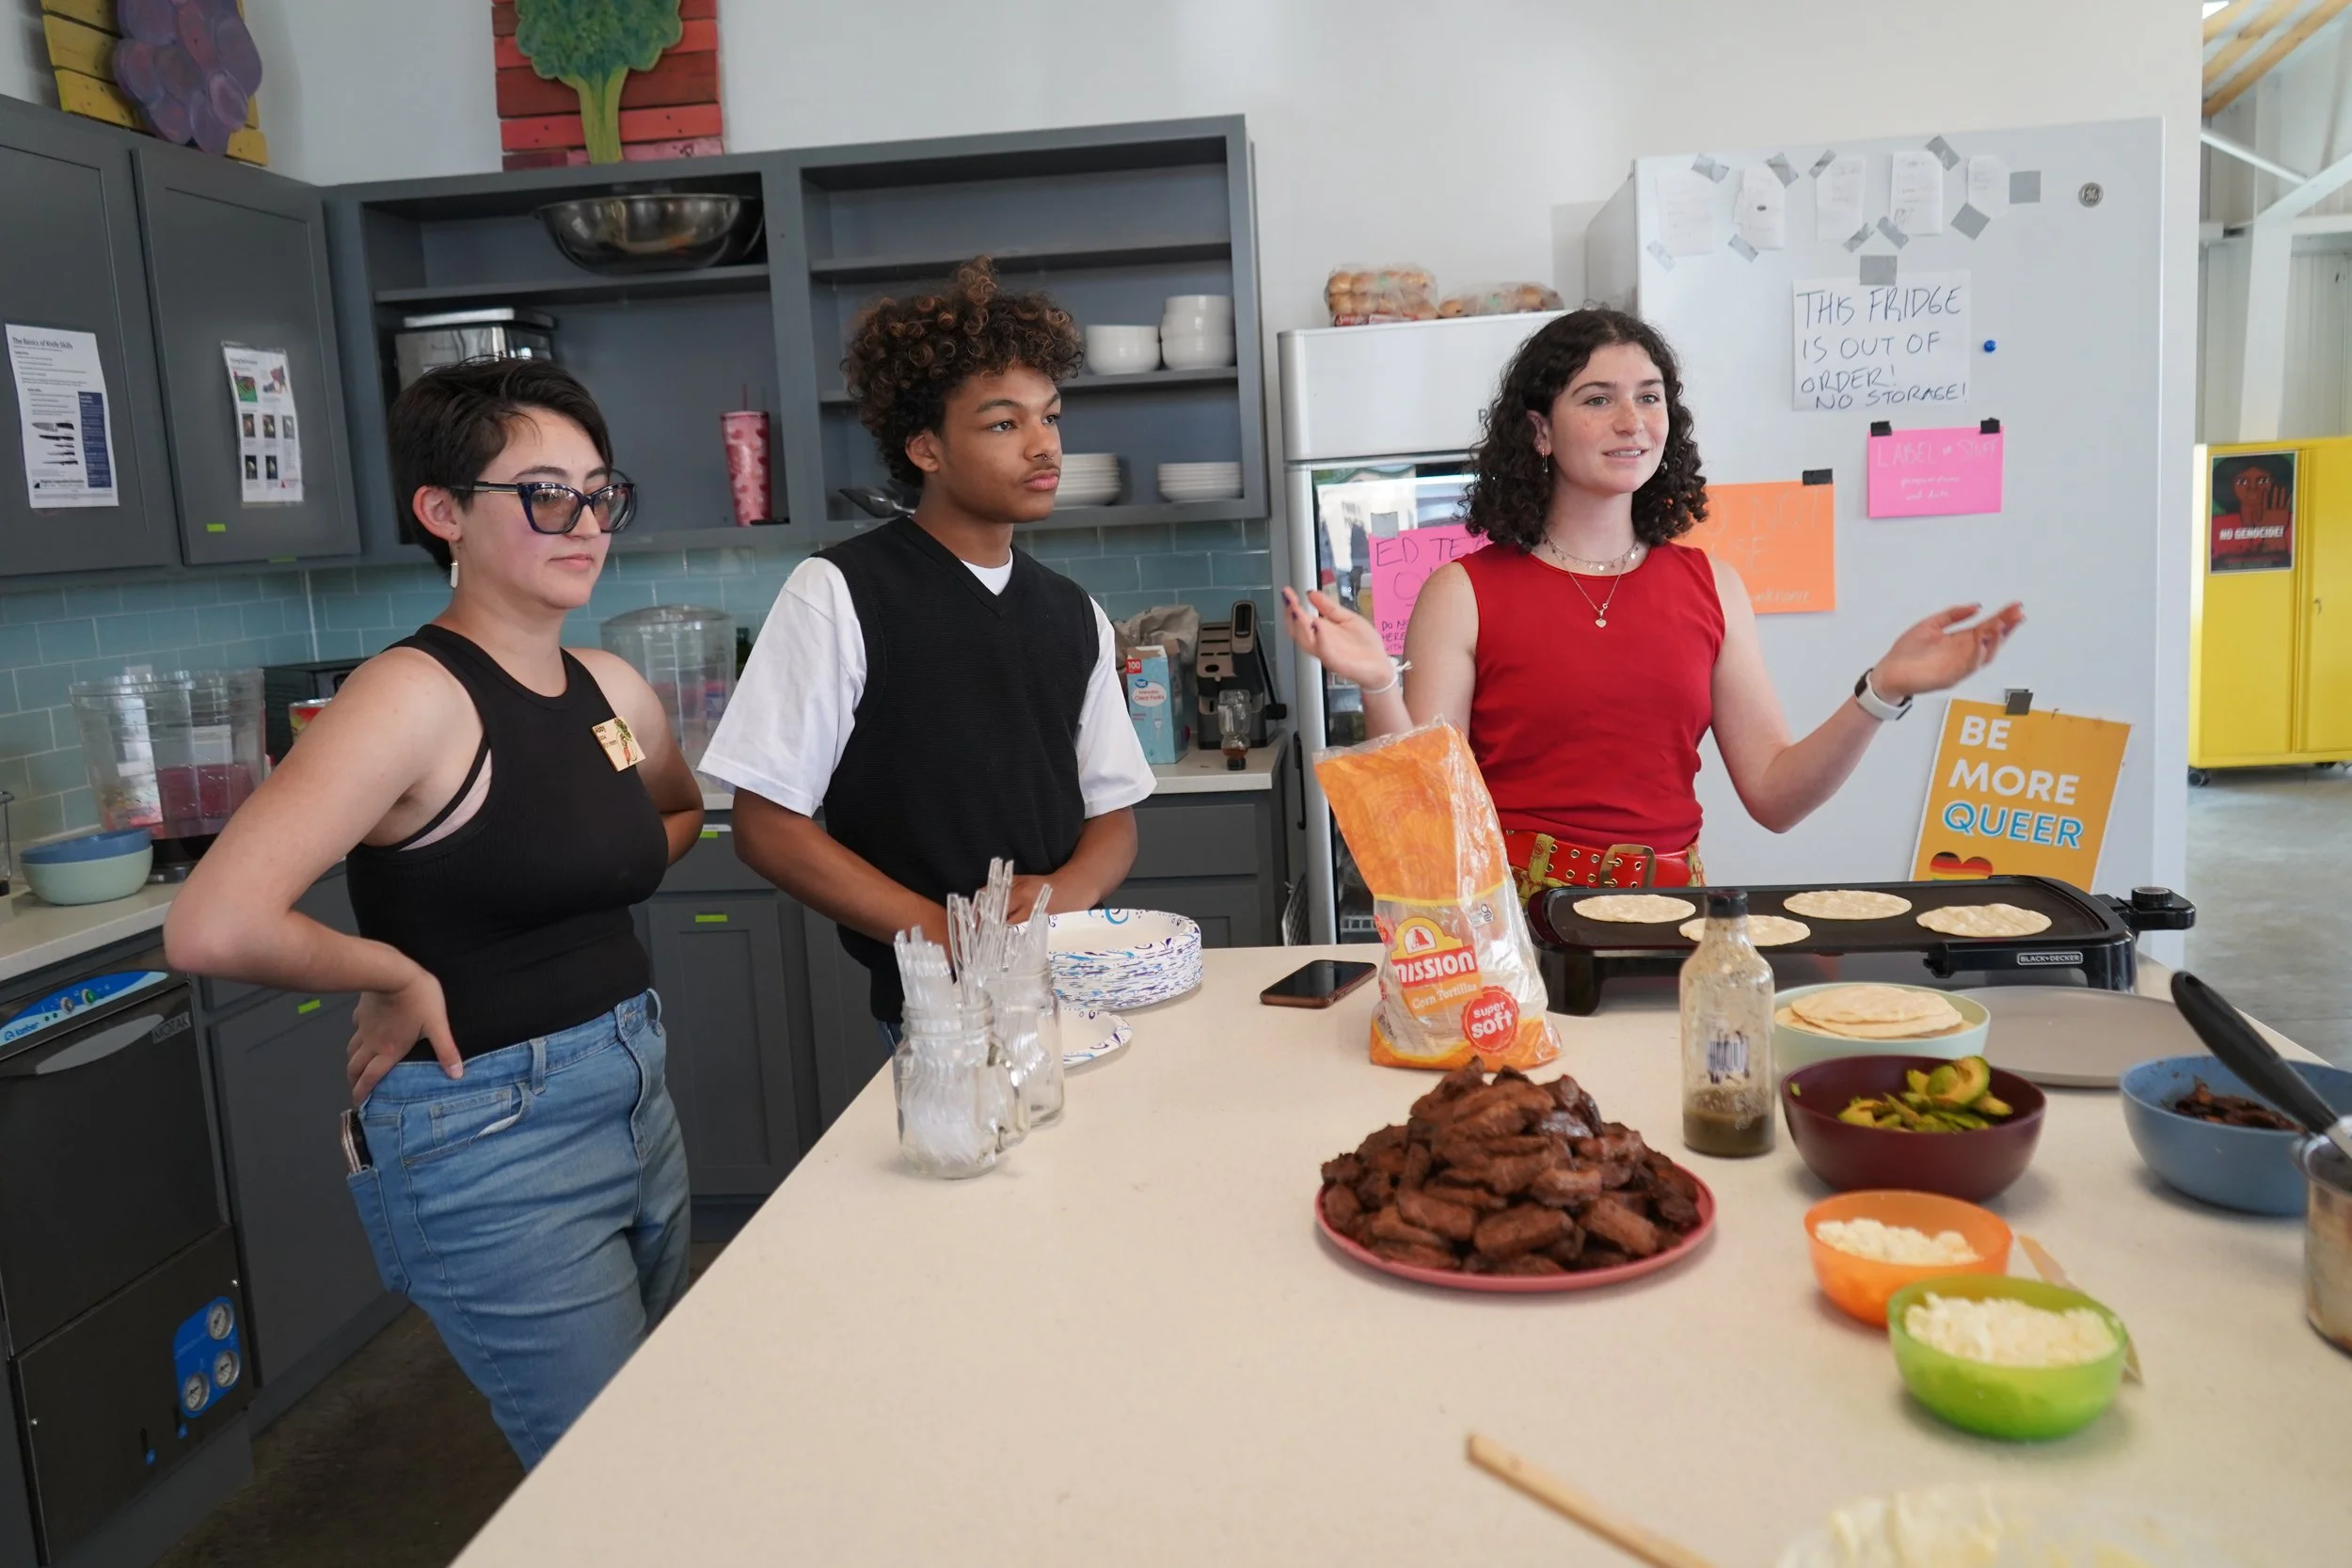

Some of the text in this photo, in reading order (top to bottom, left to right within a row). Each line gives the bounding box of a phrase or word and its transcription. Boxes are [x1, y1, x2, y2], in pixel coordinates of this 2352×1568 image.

[1796, 286, 1963, 329] THIS FRIDGE
[1803, 331, 1941, 364] IS OUT OF
[1801, 364, 1898, 394] ORDER!
[1816, 382, 1967, 410] NO STORAGE!
[1877, 441, 1938, 467] LABEL
[2219, 529, 2233, 541] NO
[1375, 537, 1420, 567] ED
[1381, 621, 1393, 632] DO
[1960, 715, 2011, 751] BE
[1947, 759, 2080, 806] MORE
[1942, 800, 2084, 850] QUEER
[1412, 995, 1436, 1010] Corn
[1473, 1000, 1506, 1020] super
[1470, 1010, 1513, 1039] soft
